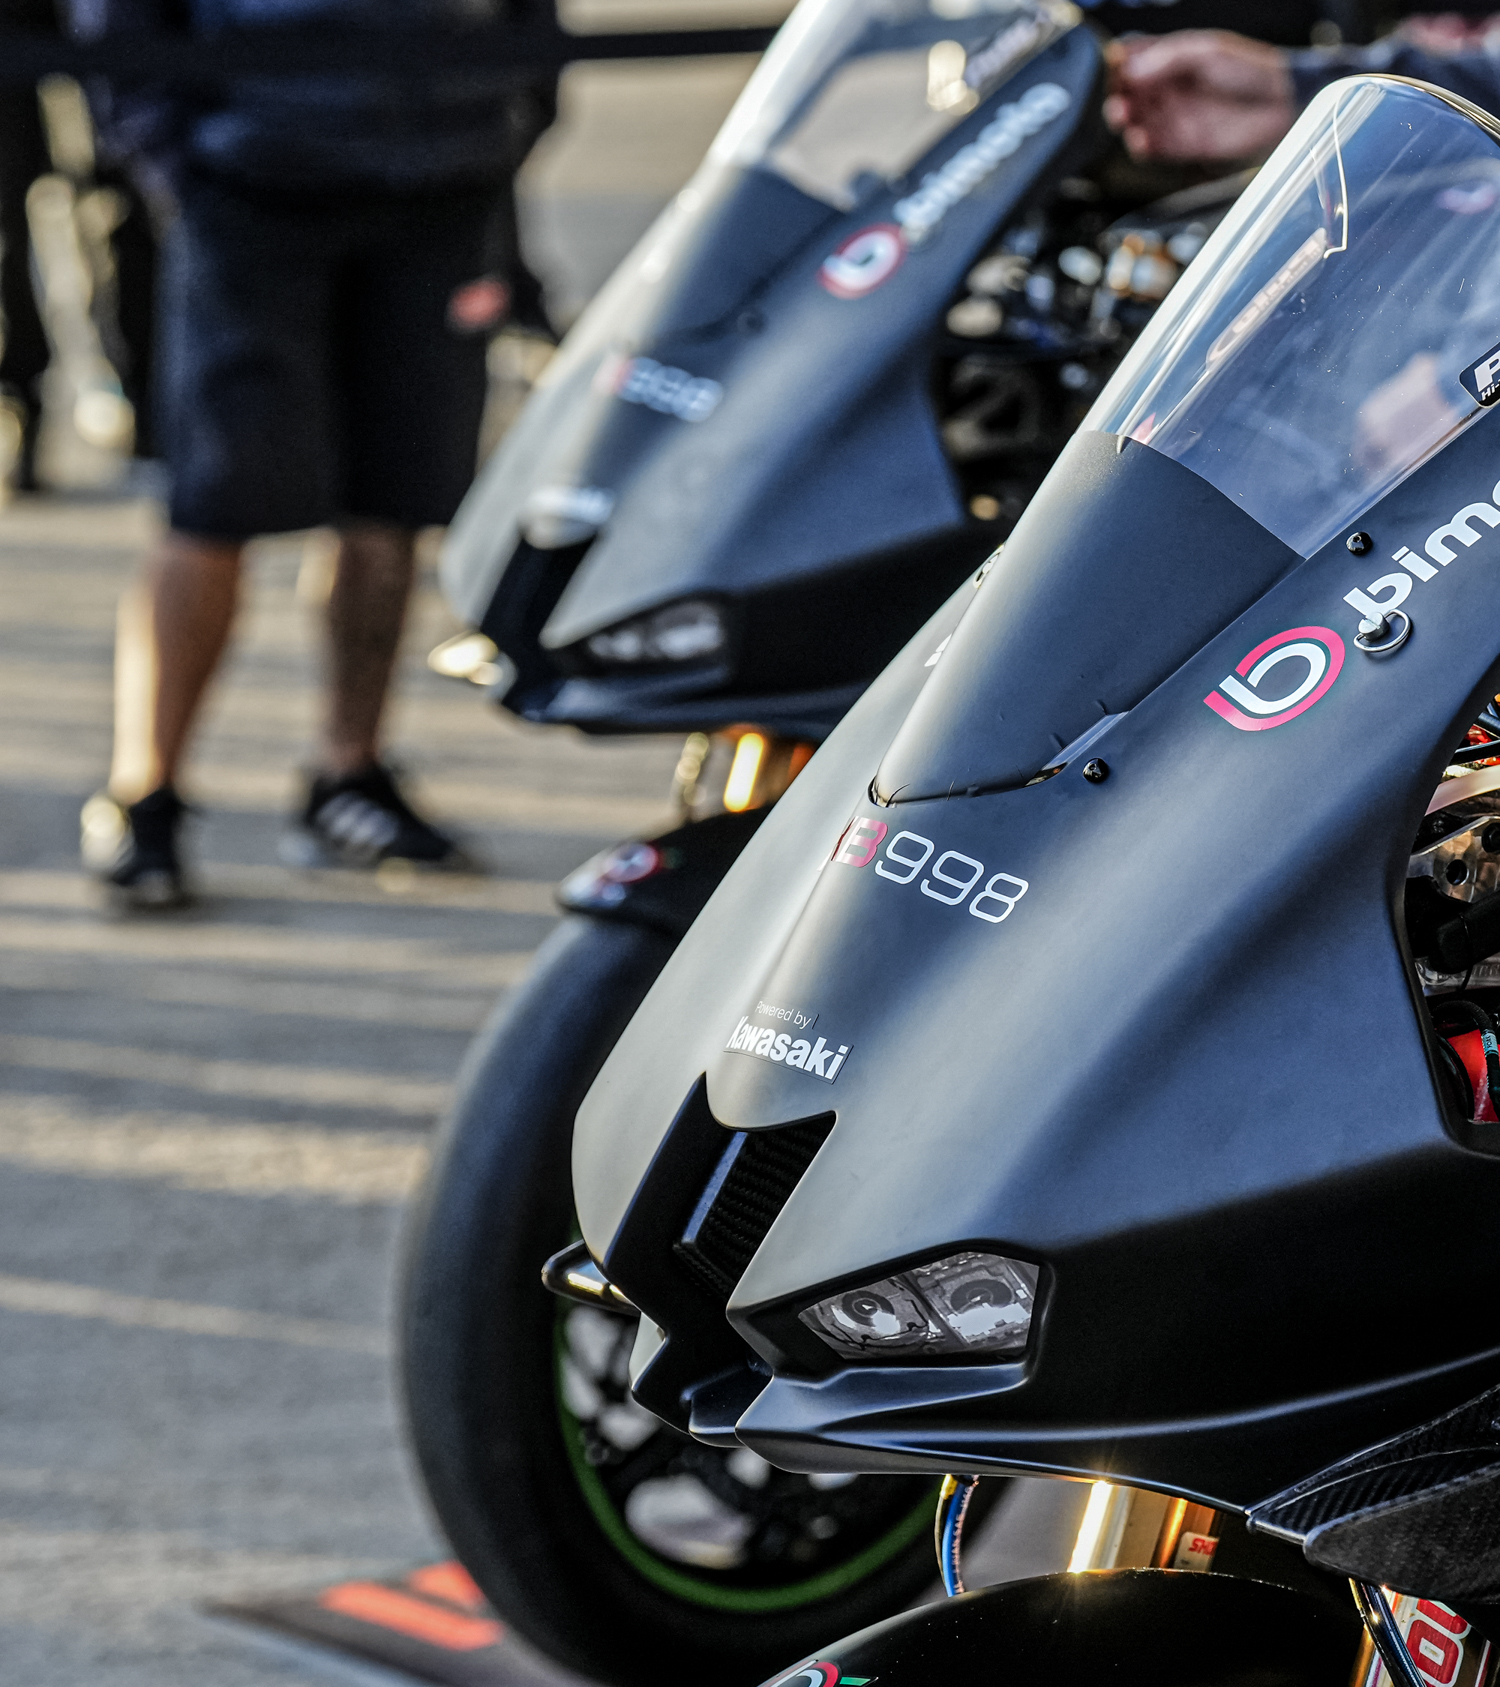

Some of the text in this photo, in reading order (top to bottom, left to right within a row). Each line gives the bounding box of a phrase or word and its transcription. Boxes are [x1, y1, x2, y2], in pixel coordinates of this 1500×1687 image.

[754, 1001, 811, 1029] Powered by
[726, 1016, 849, 1080] Kawasaki
